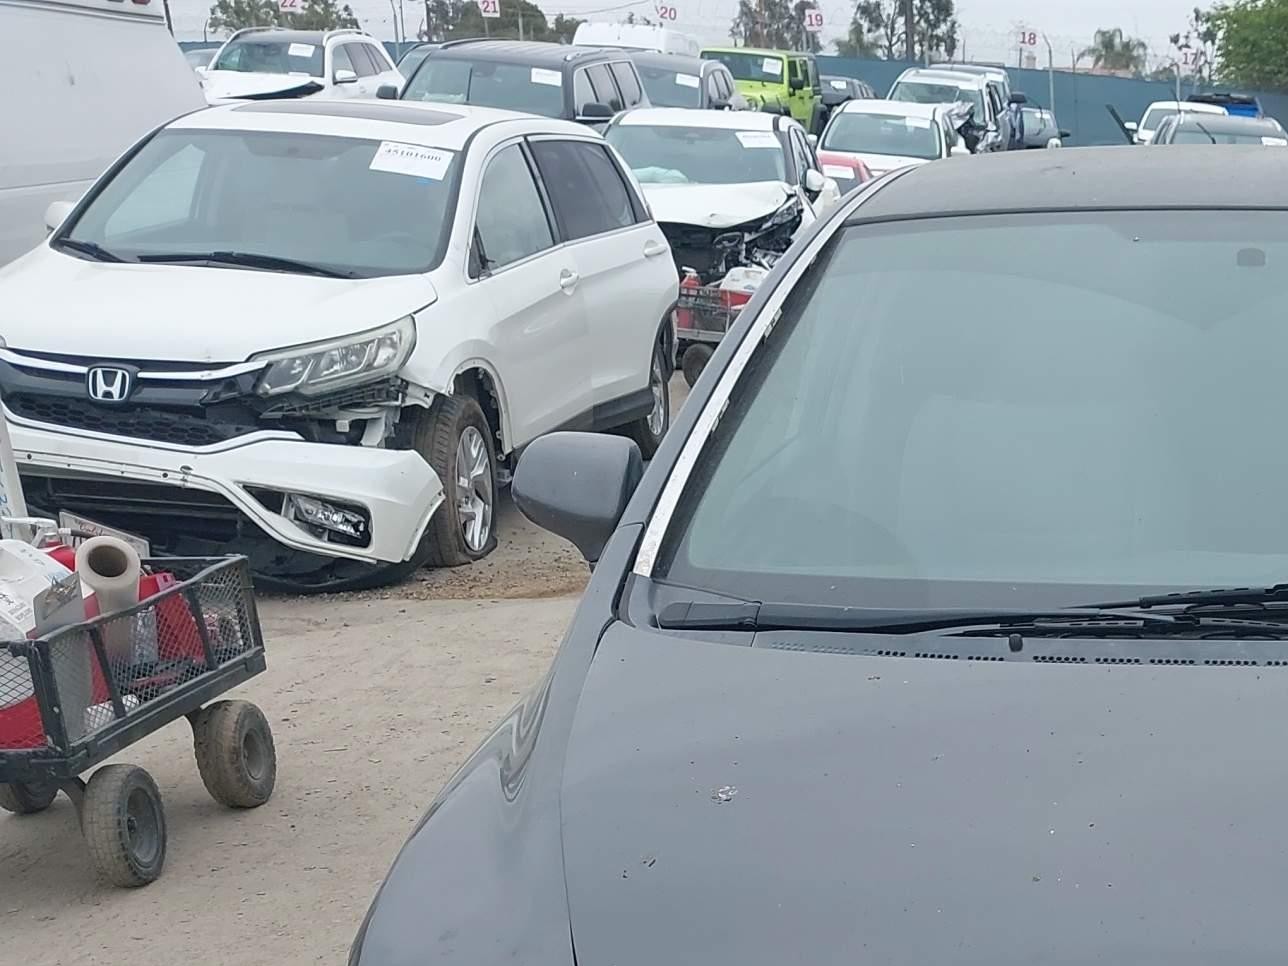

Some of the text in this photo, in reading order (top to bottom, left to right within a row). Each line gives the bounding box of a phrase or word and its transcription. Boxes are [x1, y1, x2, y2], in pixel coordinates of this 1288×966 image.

[483, 1, 498, 13] 21
[659, 6, 677, 20] 20
[807, 14, 823, 27] 19
[1020, 31, 1036, 45] 18
[1182, 52, 1198, 65] 17
